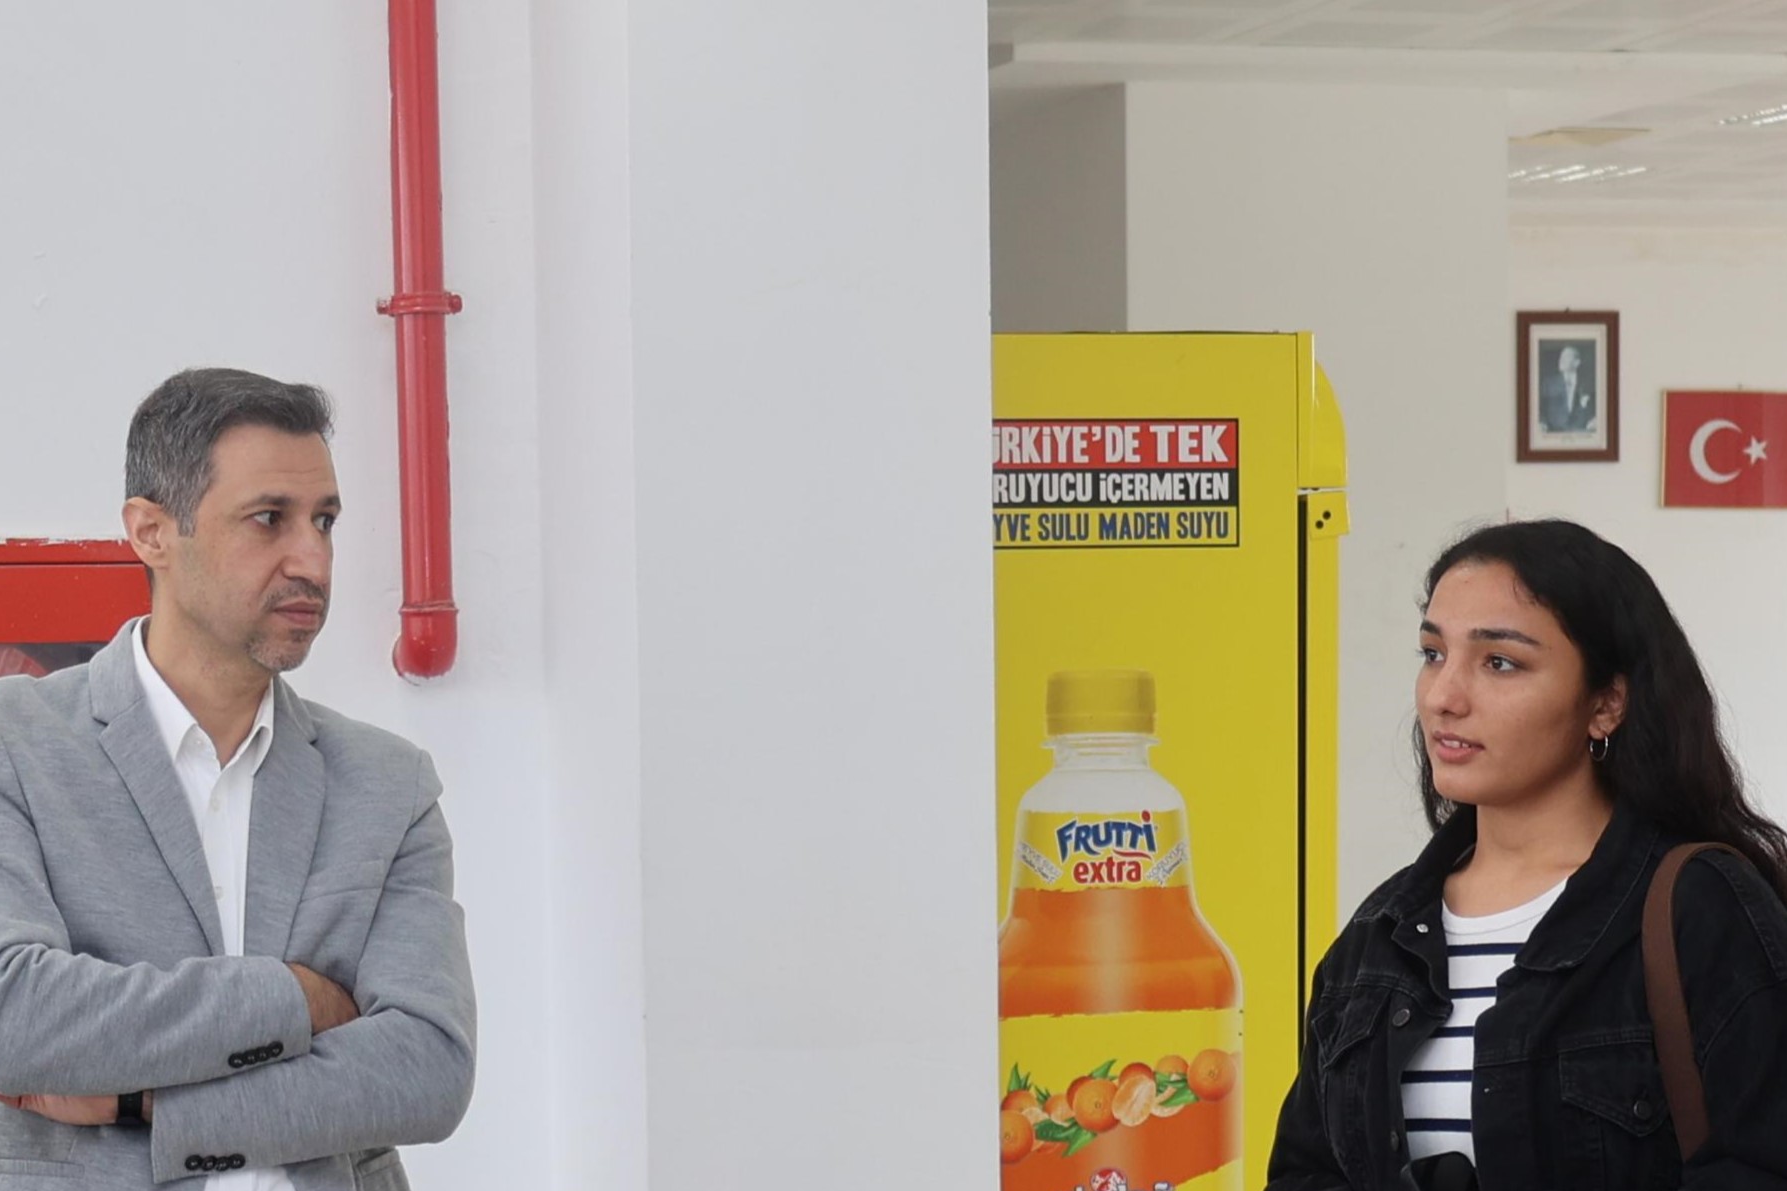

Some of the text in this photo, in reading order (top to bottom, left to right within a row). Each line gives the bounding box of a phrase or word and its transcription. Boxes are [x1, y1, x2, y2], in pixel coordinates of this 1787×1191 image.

[1149, 424, 1229, 464] TEK
[1099, 472, 1230, 504] İÇERMEYEN
[1038, 513, 1090, 541] SULU
[1098, 512, 1170, 540] MADEN
[1177, 511, 1229, 539] SUYU
[1073, 855, 1142, 883] extra
